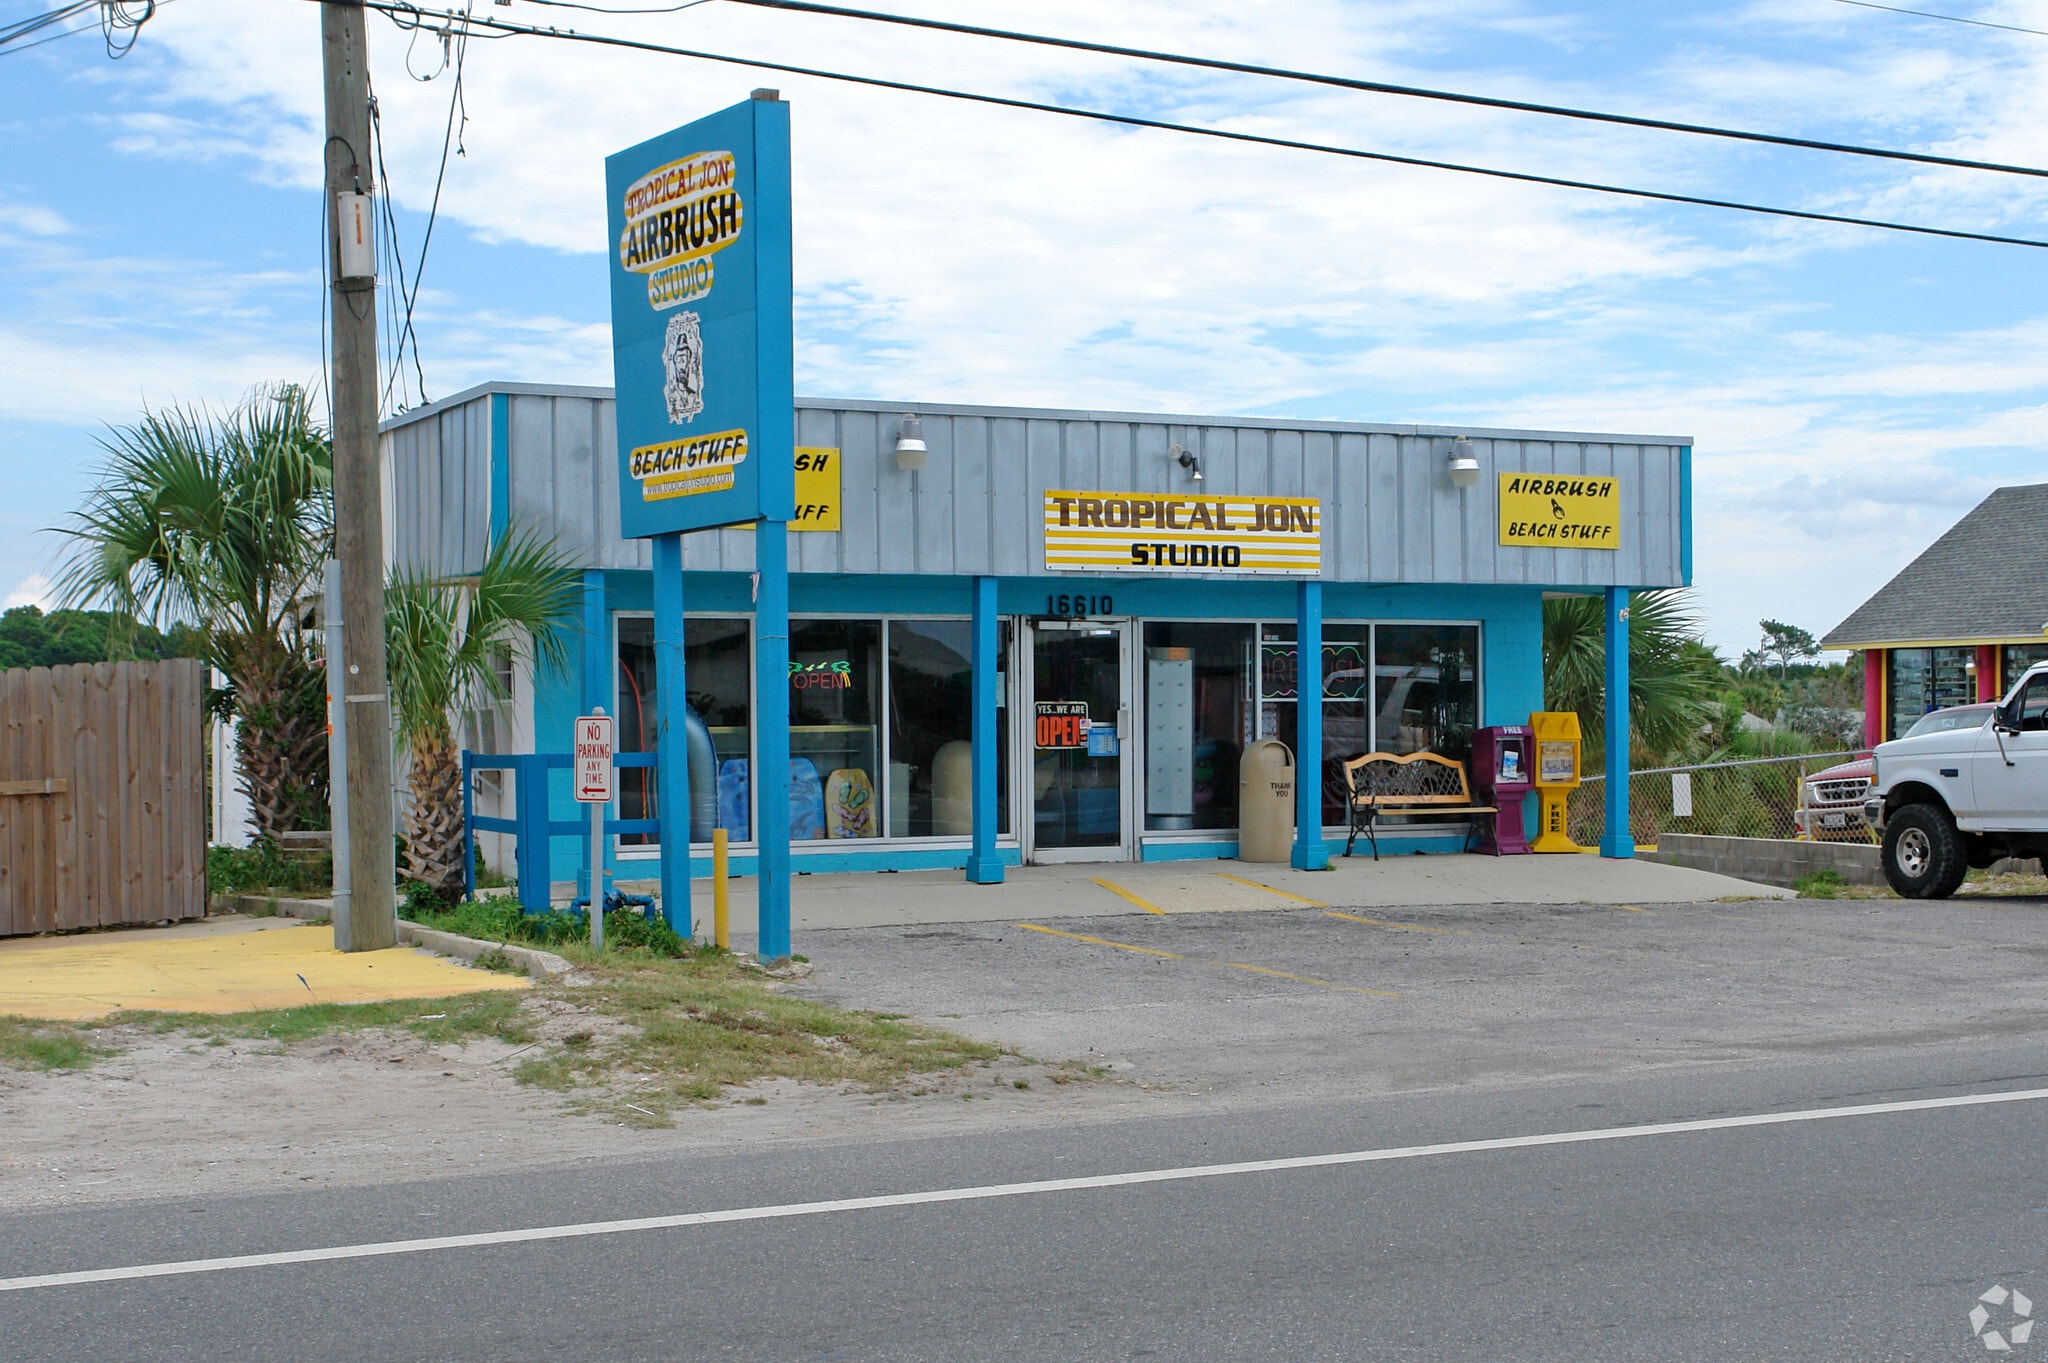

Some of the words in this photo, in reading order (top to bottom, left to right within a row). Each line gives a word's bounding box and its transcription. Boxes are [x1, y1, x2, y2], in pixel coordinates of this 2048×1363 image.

[628, 163, 695, 218] TROPICAL
[699, 160, 730, 191] JON
[627, 192, 736, 267] AIRBRUSH
[652, 258, 708, 303] STUDIO
[633, 443, 684, 477] BEACH
[687, 434, 745, 468] STUFF
[1508, 478, 1612, 498] AIRBRUSH
[1053, 497, 1236, 532] TROPICAL
[1246, 504, 1314, 533] JON
[1508, 522, 1557, 538] BEACH
[1560, 524, 1612, 540] STUFF
[1131, 543, 1241, 568] STUDIO
[1048, 594, 1113, 616] 16610
[793, 672, 843, 690] OPEN
[1071, 705, 1085, 714] ARE
[587, 725, 600, 740] NO
[1502, 726, 1523, 734] FREE
[578, 744, 610, 759] PARKING
[586, 761, 600, 771] ANY
[585, 773, 602, 784] TIME
[1275, 790, 1289, 798] YOU
[1551, 804, 1560, 832] FREE
